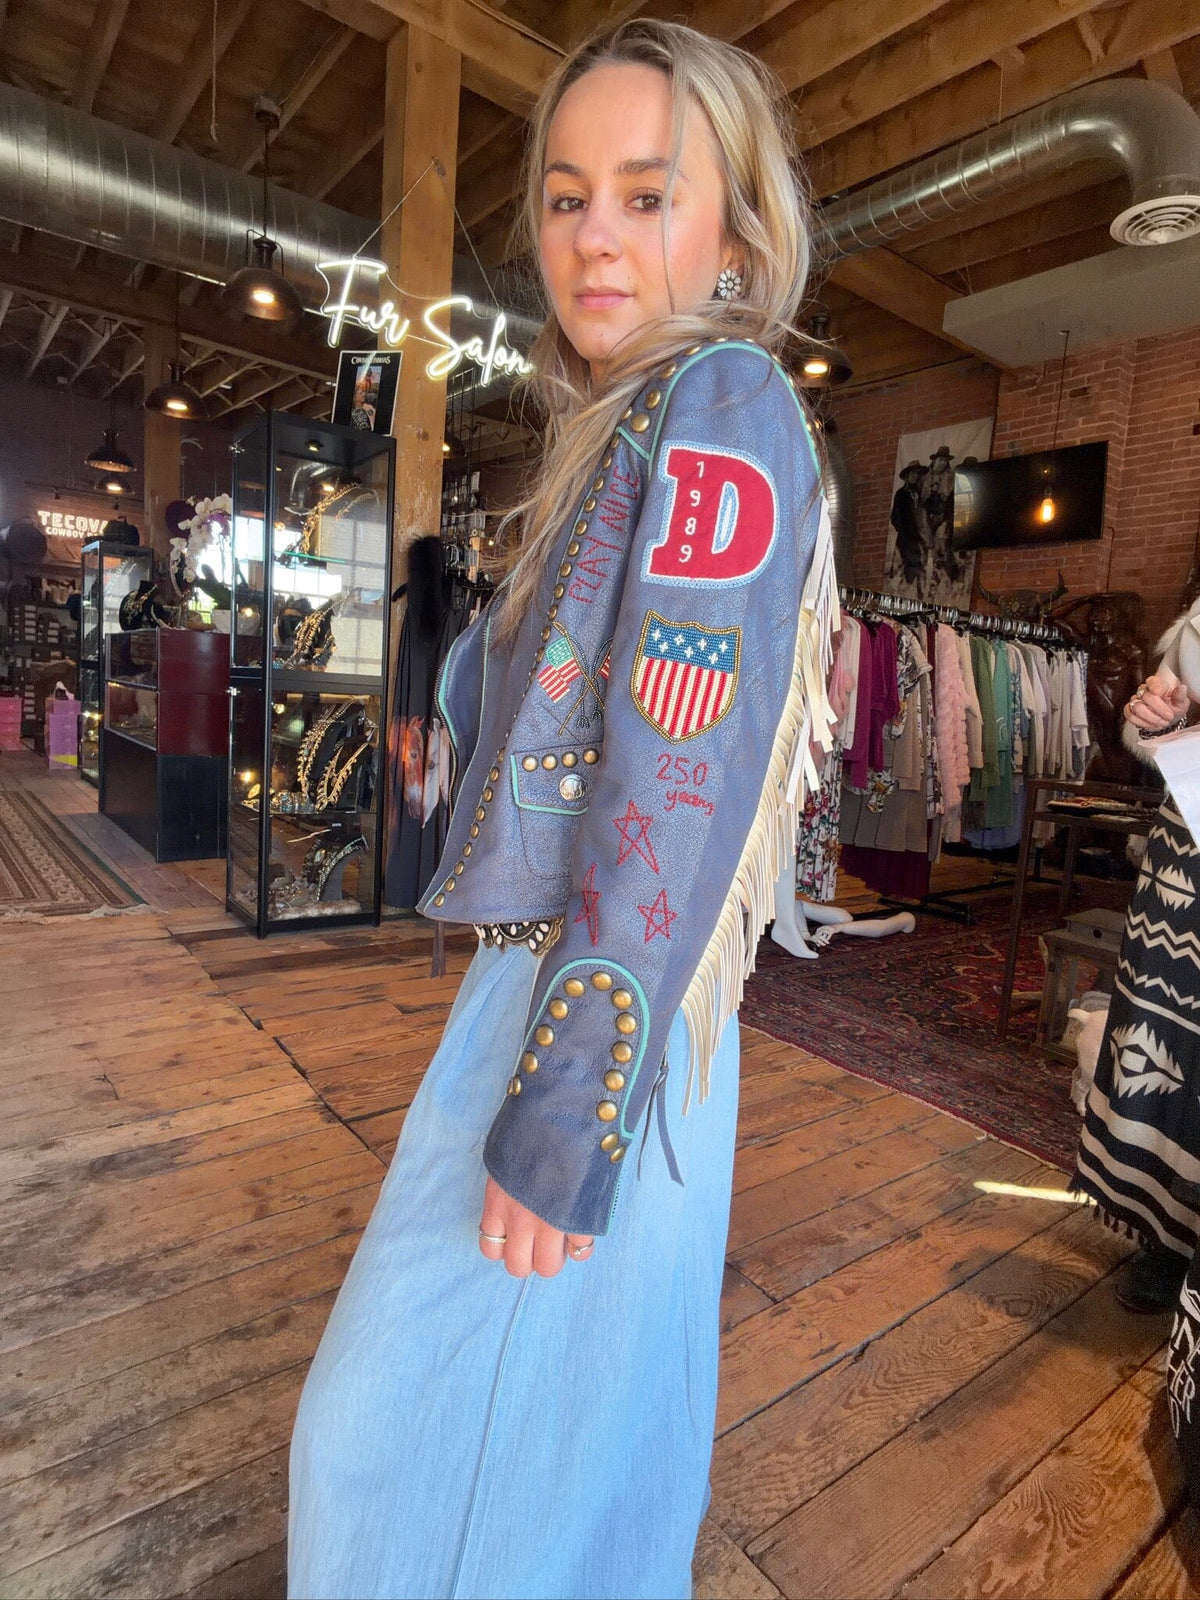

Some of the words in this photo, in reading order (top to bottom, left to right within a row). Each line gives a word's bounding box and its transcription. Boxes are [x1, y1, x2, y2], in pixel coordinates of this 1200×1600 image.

[317, 256, 410, 347] Fur
[423, 296, 533, 386] Salon
[567, 534, 622, 604] PLAY
[599, 465, 641, 533] NICE
[656, 752, 709, 787] 250
